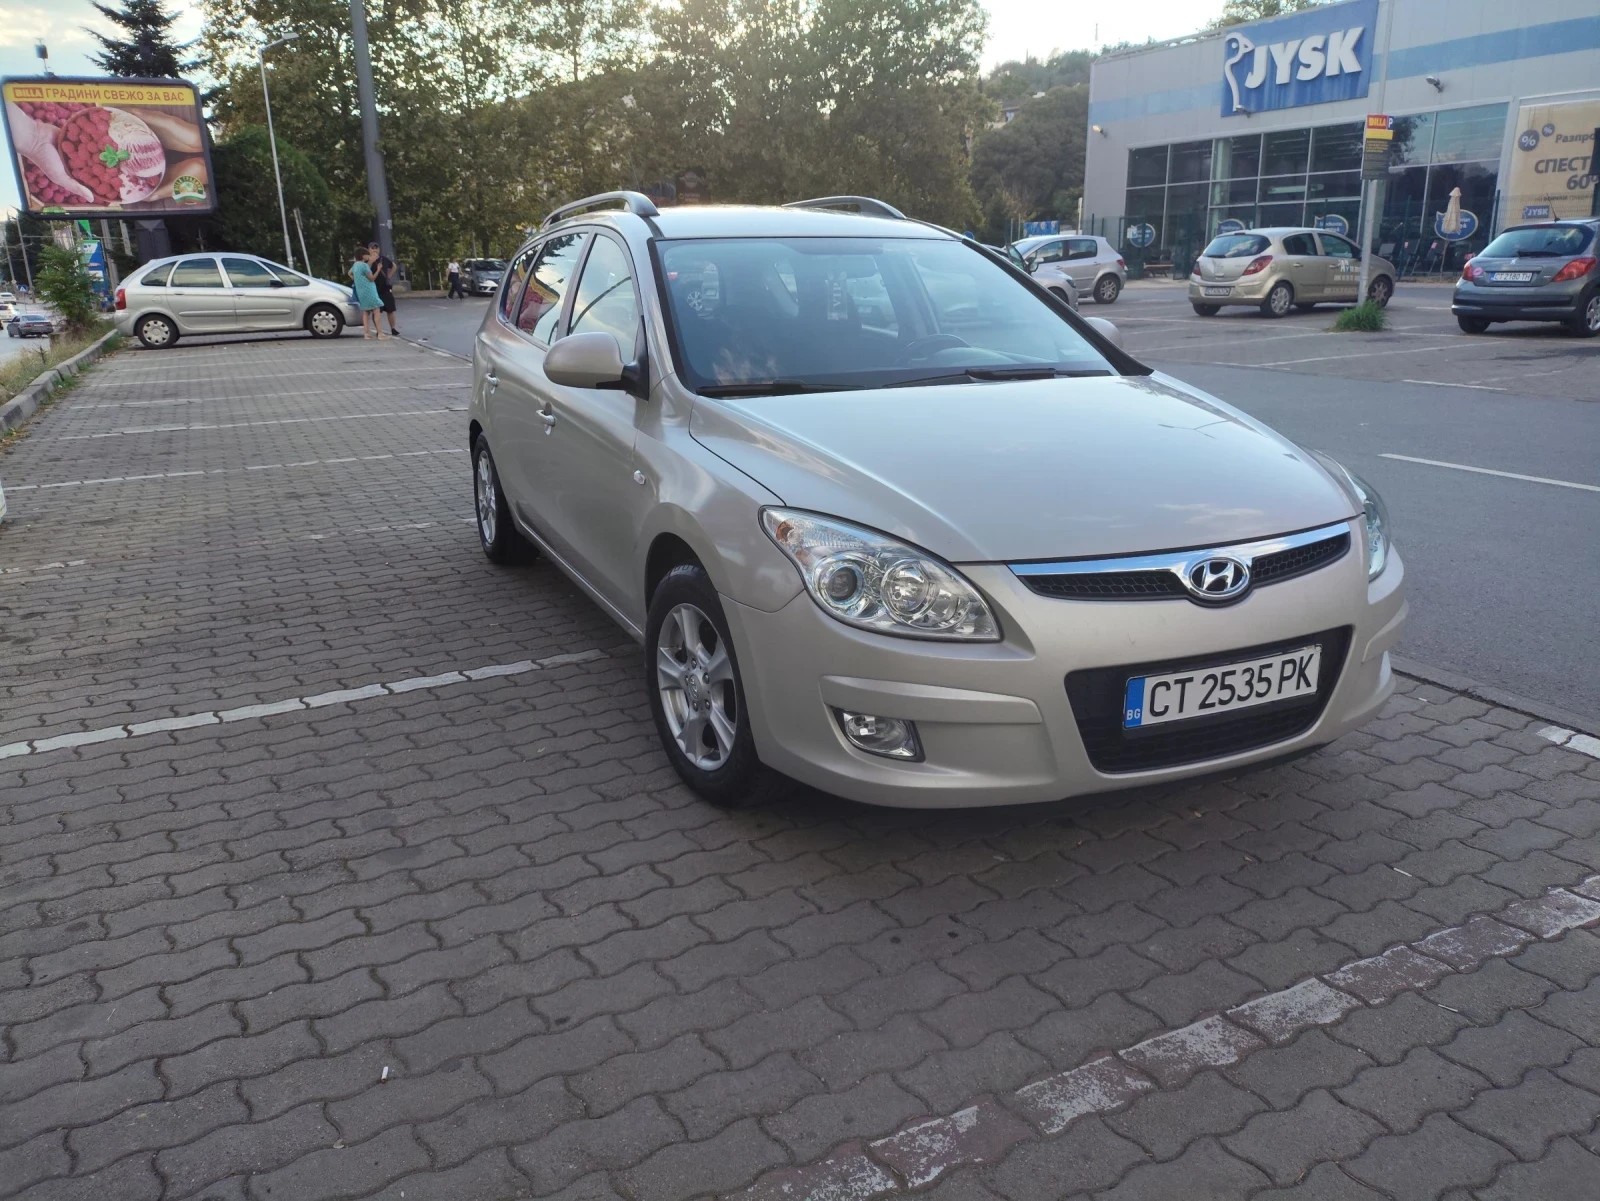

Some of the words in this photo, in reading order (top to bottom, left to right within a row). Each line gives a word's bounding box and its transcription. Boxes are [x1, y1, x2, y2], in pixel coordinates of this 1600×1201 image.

[1245, 27, 1364, 88] JYSK
[46, 89, 100, 100] ГРАДИНИ
[104, 90, 144, 101] СВЕЖО
[147, 91, 161, 101] ЗА
[164, 92, 184, 102] ВАС
[1388, 117, 1394, 128] P
[1527, 208, 1549, 216] JYSK
[1149, 676, 1195, 717] CT
[1197, 662, 1274, 710] 2535
[1276, 653, 1315, 695] PK
[1126, 708, 1141, 720] BG
